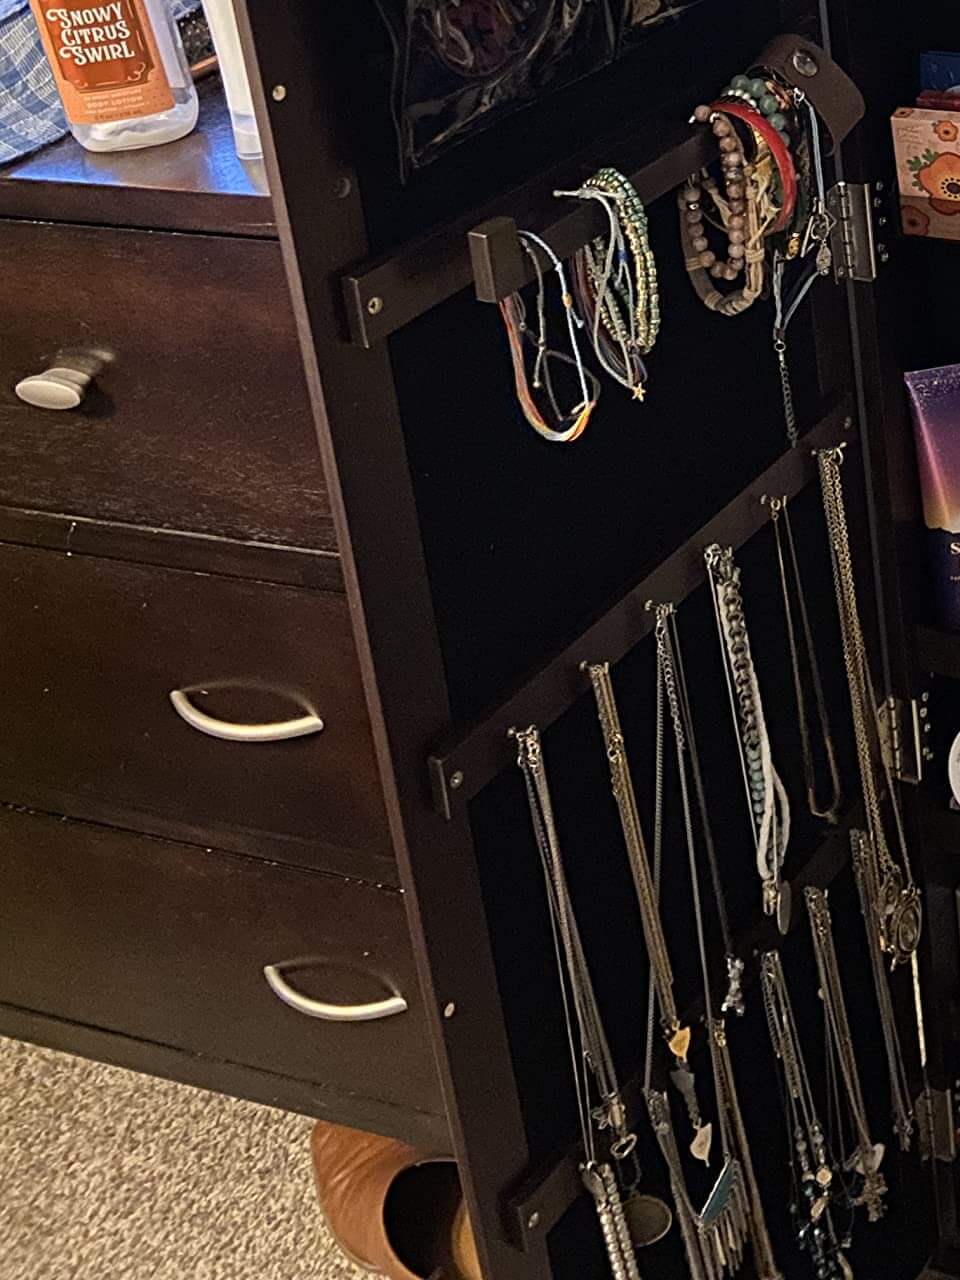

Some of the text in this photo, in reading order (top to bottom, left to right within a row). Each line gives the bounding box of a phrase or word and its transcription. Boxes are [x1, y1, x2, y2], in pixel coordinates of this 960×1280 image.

[46, 1, 123, 29] SNOWY
[61, 20, 131, 47] CITRUS
[59, 41, 135, 65] SWIRL
